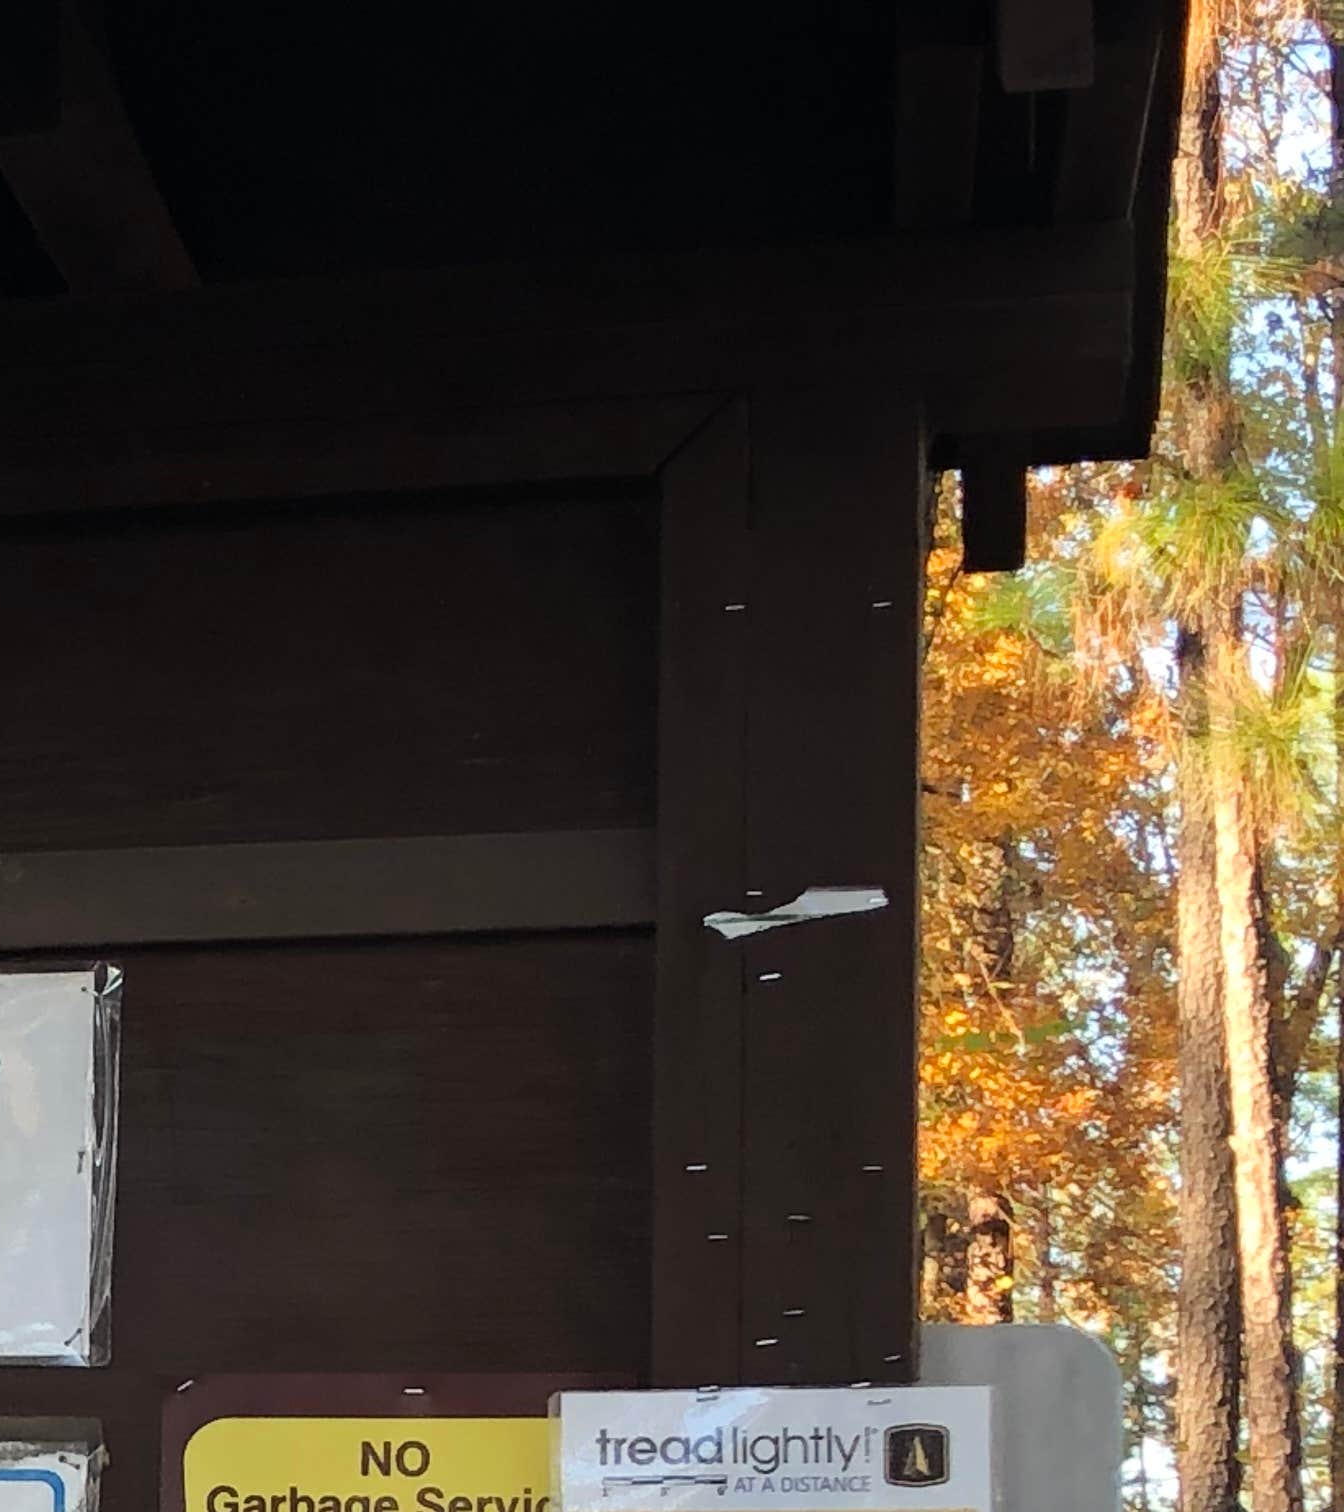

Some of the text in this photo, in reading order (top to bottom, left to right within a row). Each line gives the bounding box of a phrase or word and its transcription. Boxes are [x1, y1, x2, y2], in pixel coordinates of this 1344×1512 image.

[361, 1440, 431, 1478] NO
[734, 1475, 872, 1493] AT A DISTANCE
